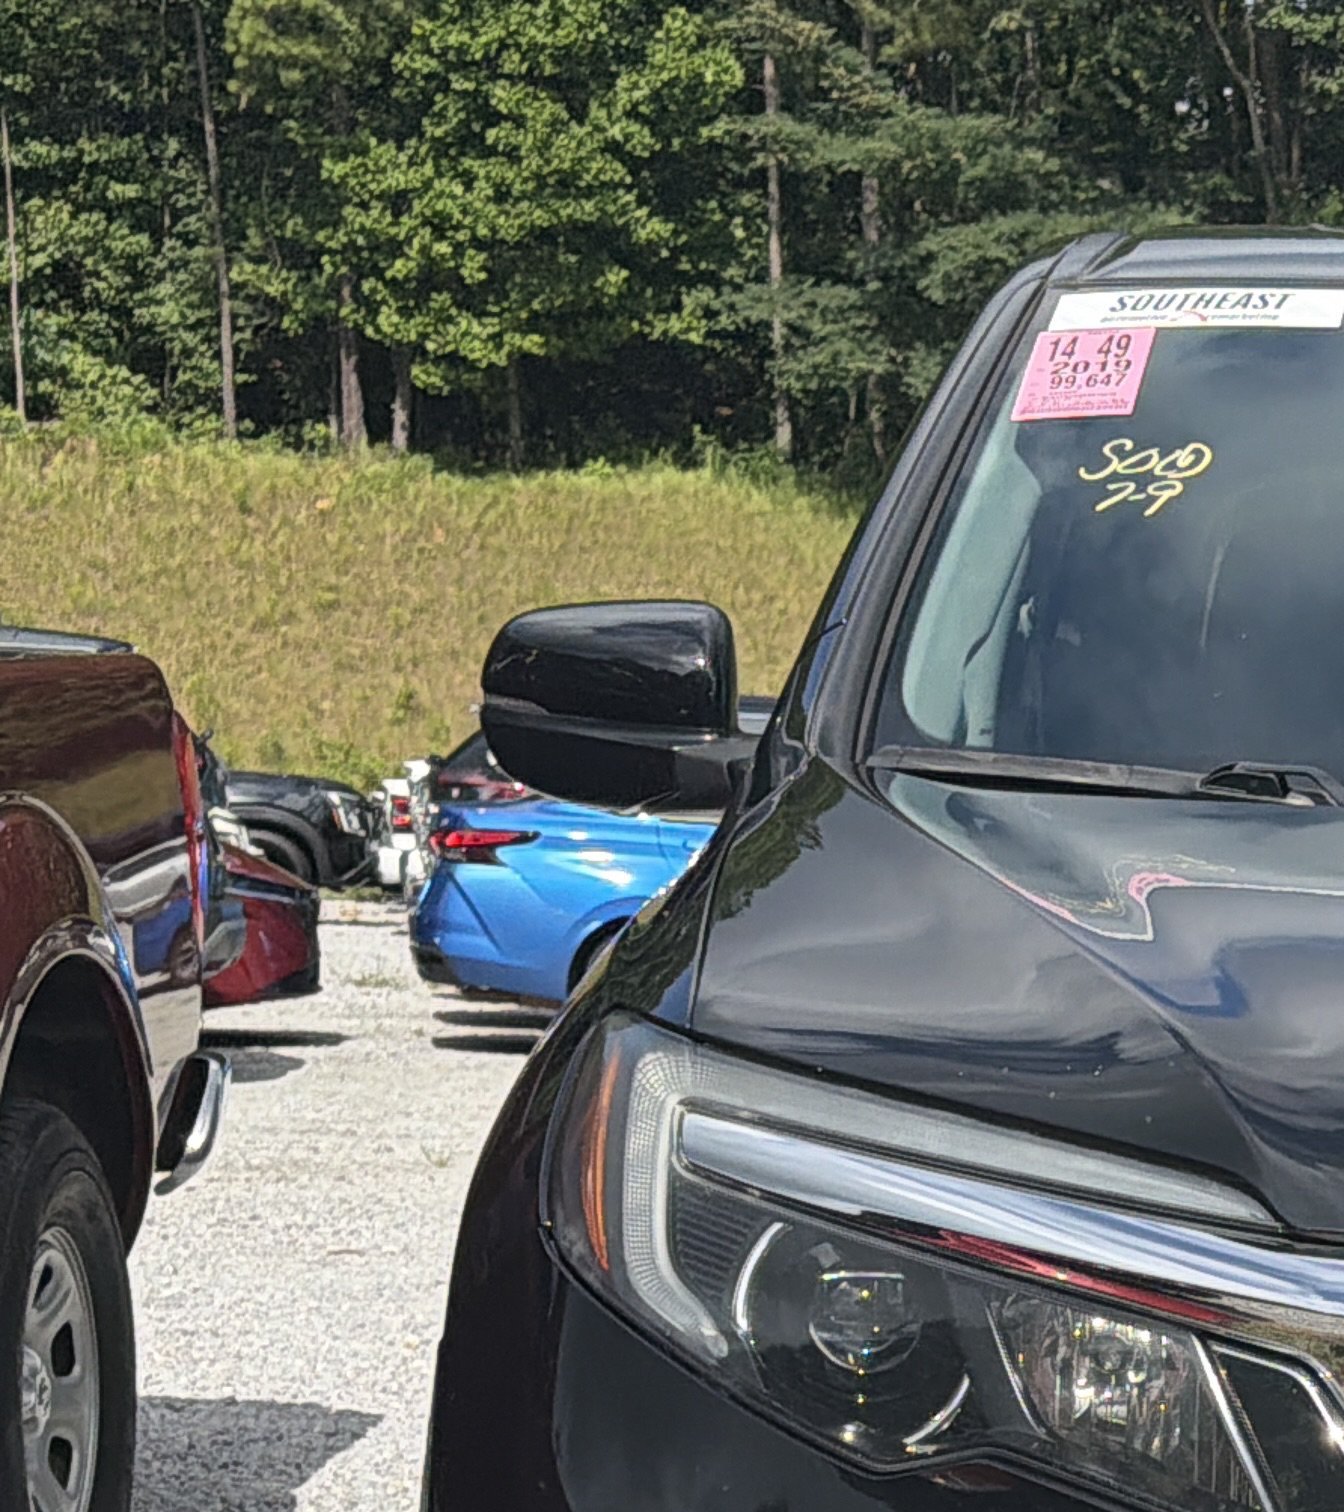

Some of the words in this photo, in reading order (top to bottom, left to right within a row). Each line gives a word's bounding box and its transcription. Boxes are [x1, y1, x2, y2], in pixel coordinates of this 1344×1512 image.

[1109, 291, 1297, 313] SOUTHEAST
[1049, 335, 1079, 362] 14
[1097, 333, 1132, 360] 49
[1050, 359, 1132, 375] 2019
[1095, 480, 1184, 517] 7-9
